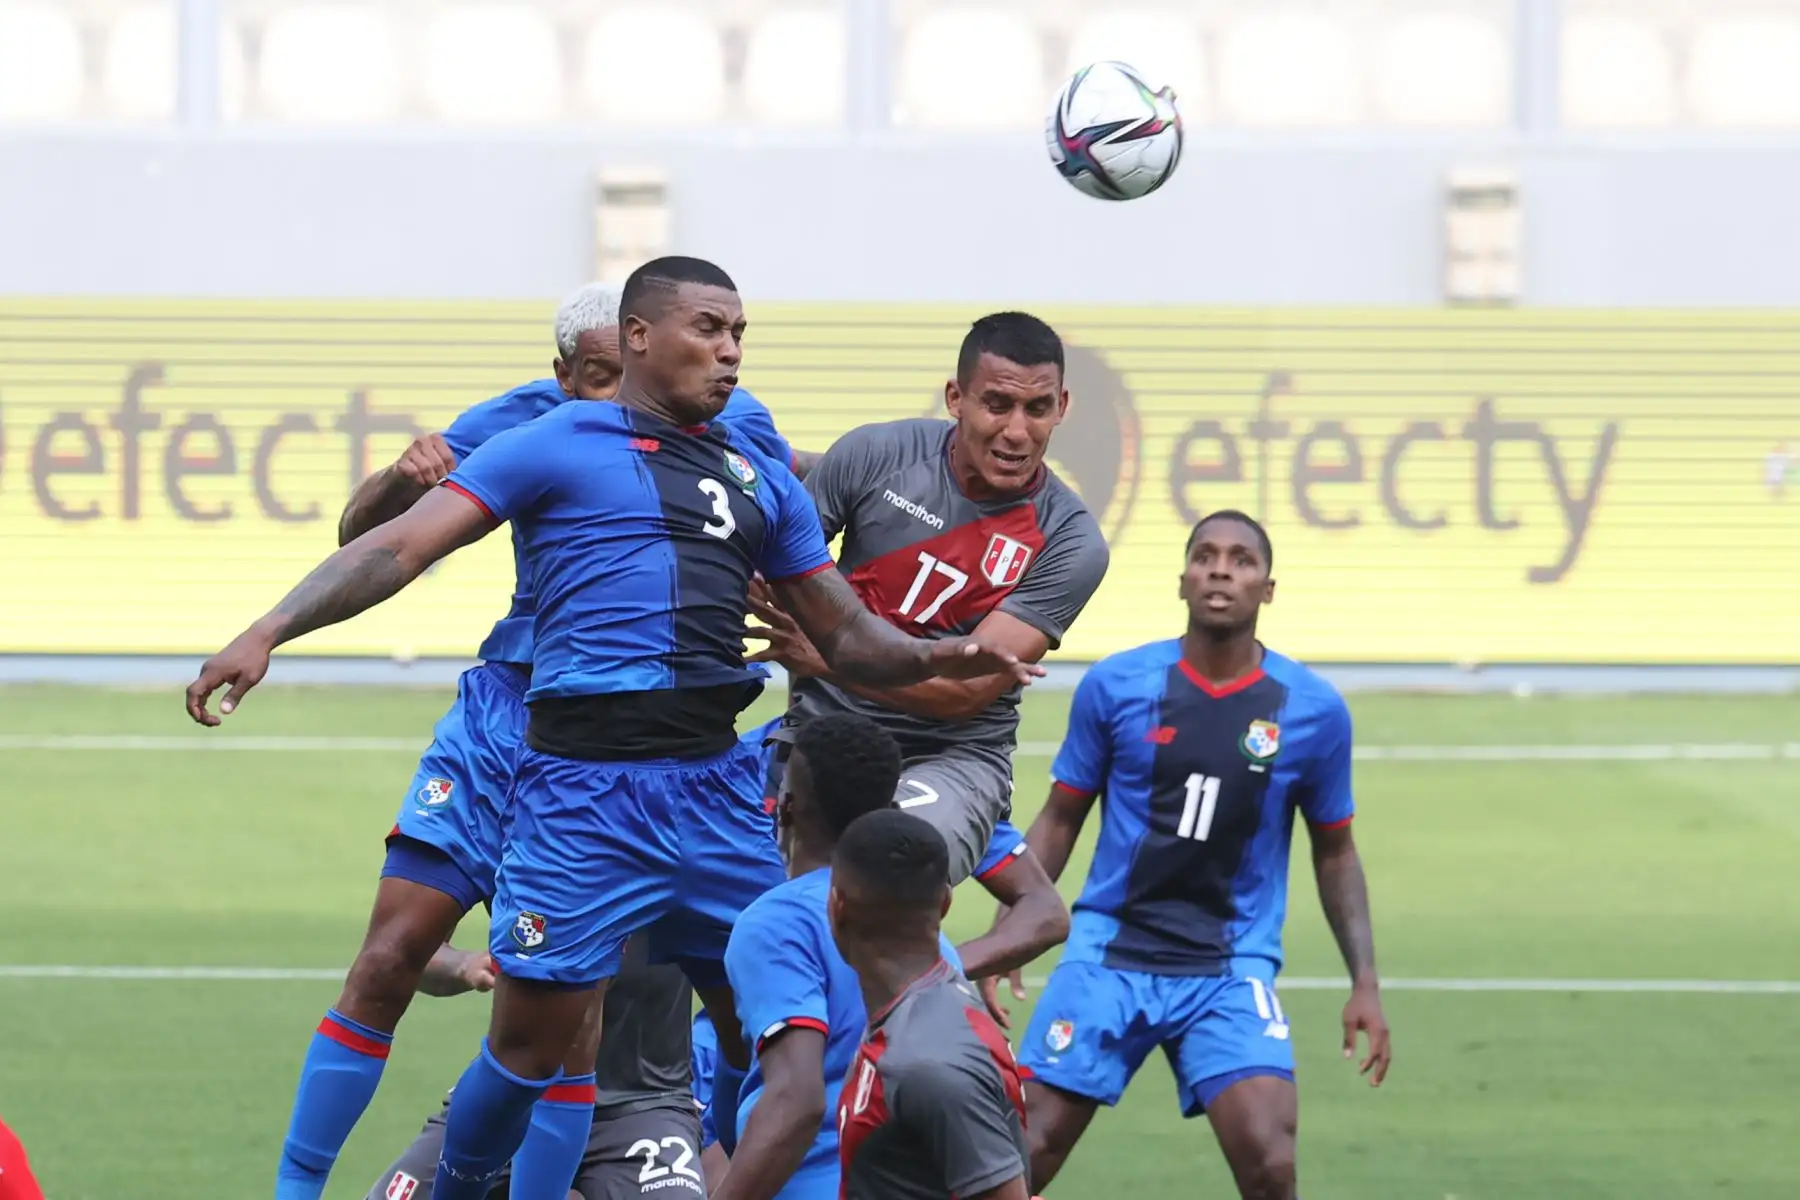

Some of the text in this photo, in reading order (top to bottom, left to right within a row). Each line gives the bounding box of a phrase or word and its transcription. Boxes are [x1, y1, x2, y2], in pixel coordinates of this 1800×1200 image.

[31, 360, 439, 522] efect
[1169, 369, 1619, 584] efecty
[697, 477, 736, 540] 3
[883, 488, 945, 530] marathon
[898, 551, 969, 624] 17
[1177, 772, 1222, 842] 11
[1245, 976, 1284, 1024] 11
[624, 1136, 701, 1184] 22
[640, 1176, 703, 1196] marathon
